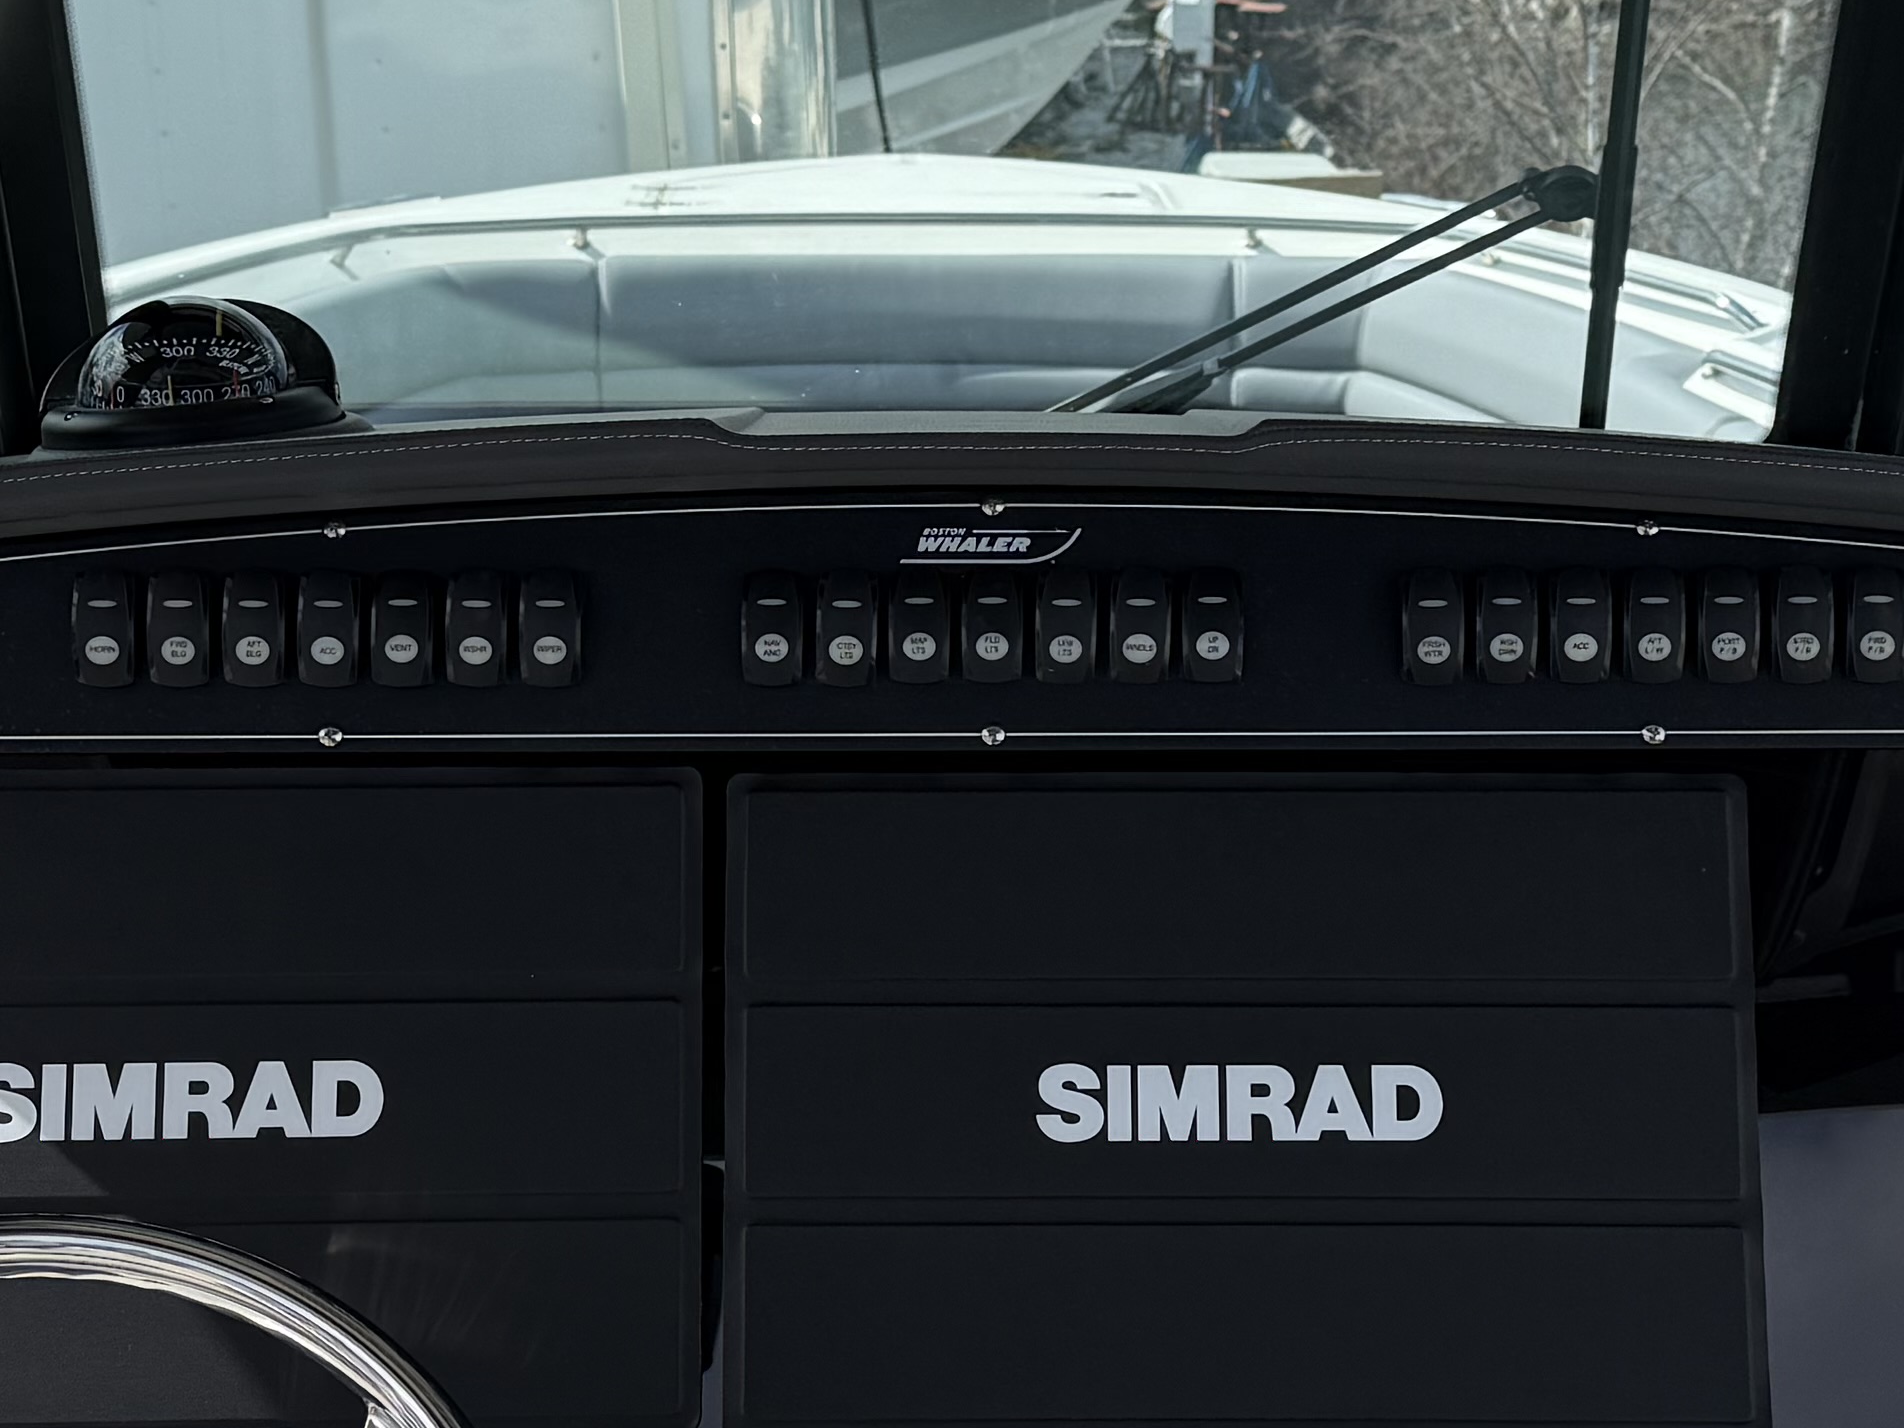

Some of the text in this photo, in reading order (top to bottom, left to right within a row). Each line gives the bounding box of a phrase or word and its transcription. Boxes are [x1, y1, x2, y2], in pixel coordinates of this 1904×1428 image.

[160, 345, 195, 358] 300
[206, 346, 240, 359] 330
[141, 388, 174, 407] 330
[180, 388, 214, 406] 300
[922, 527, 967, 536] BOSTON
[917, 536, 1031, 553] WHALER
[1035, 1062, 1444, 1143] SIMRAD
